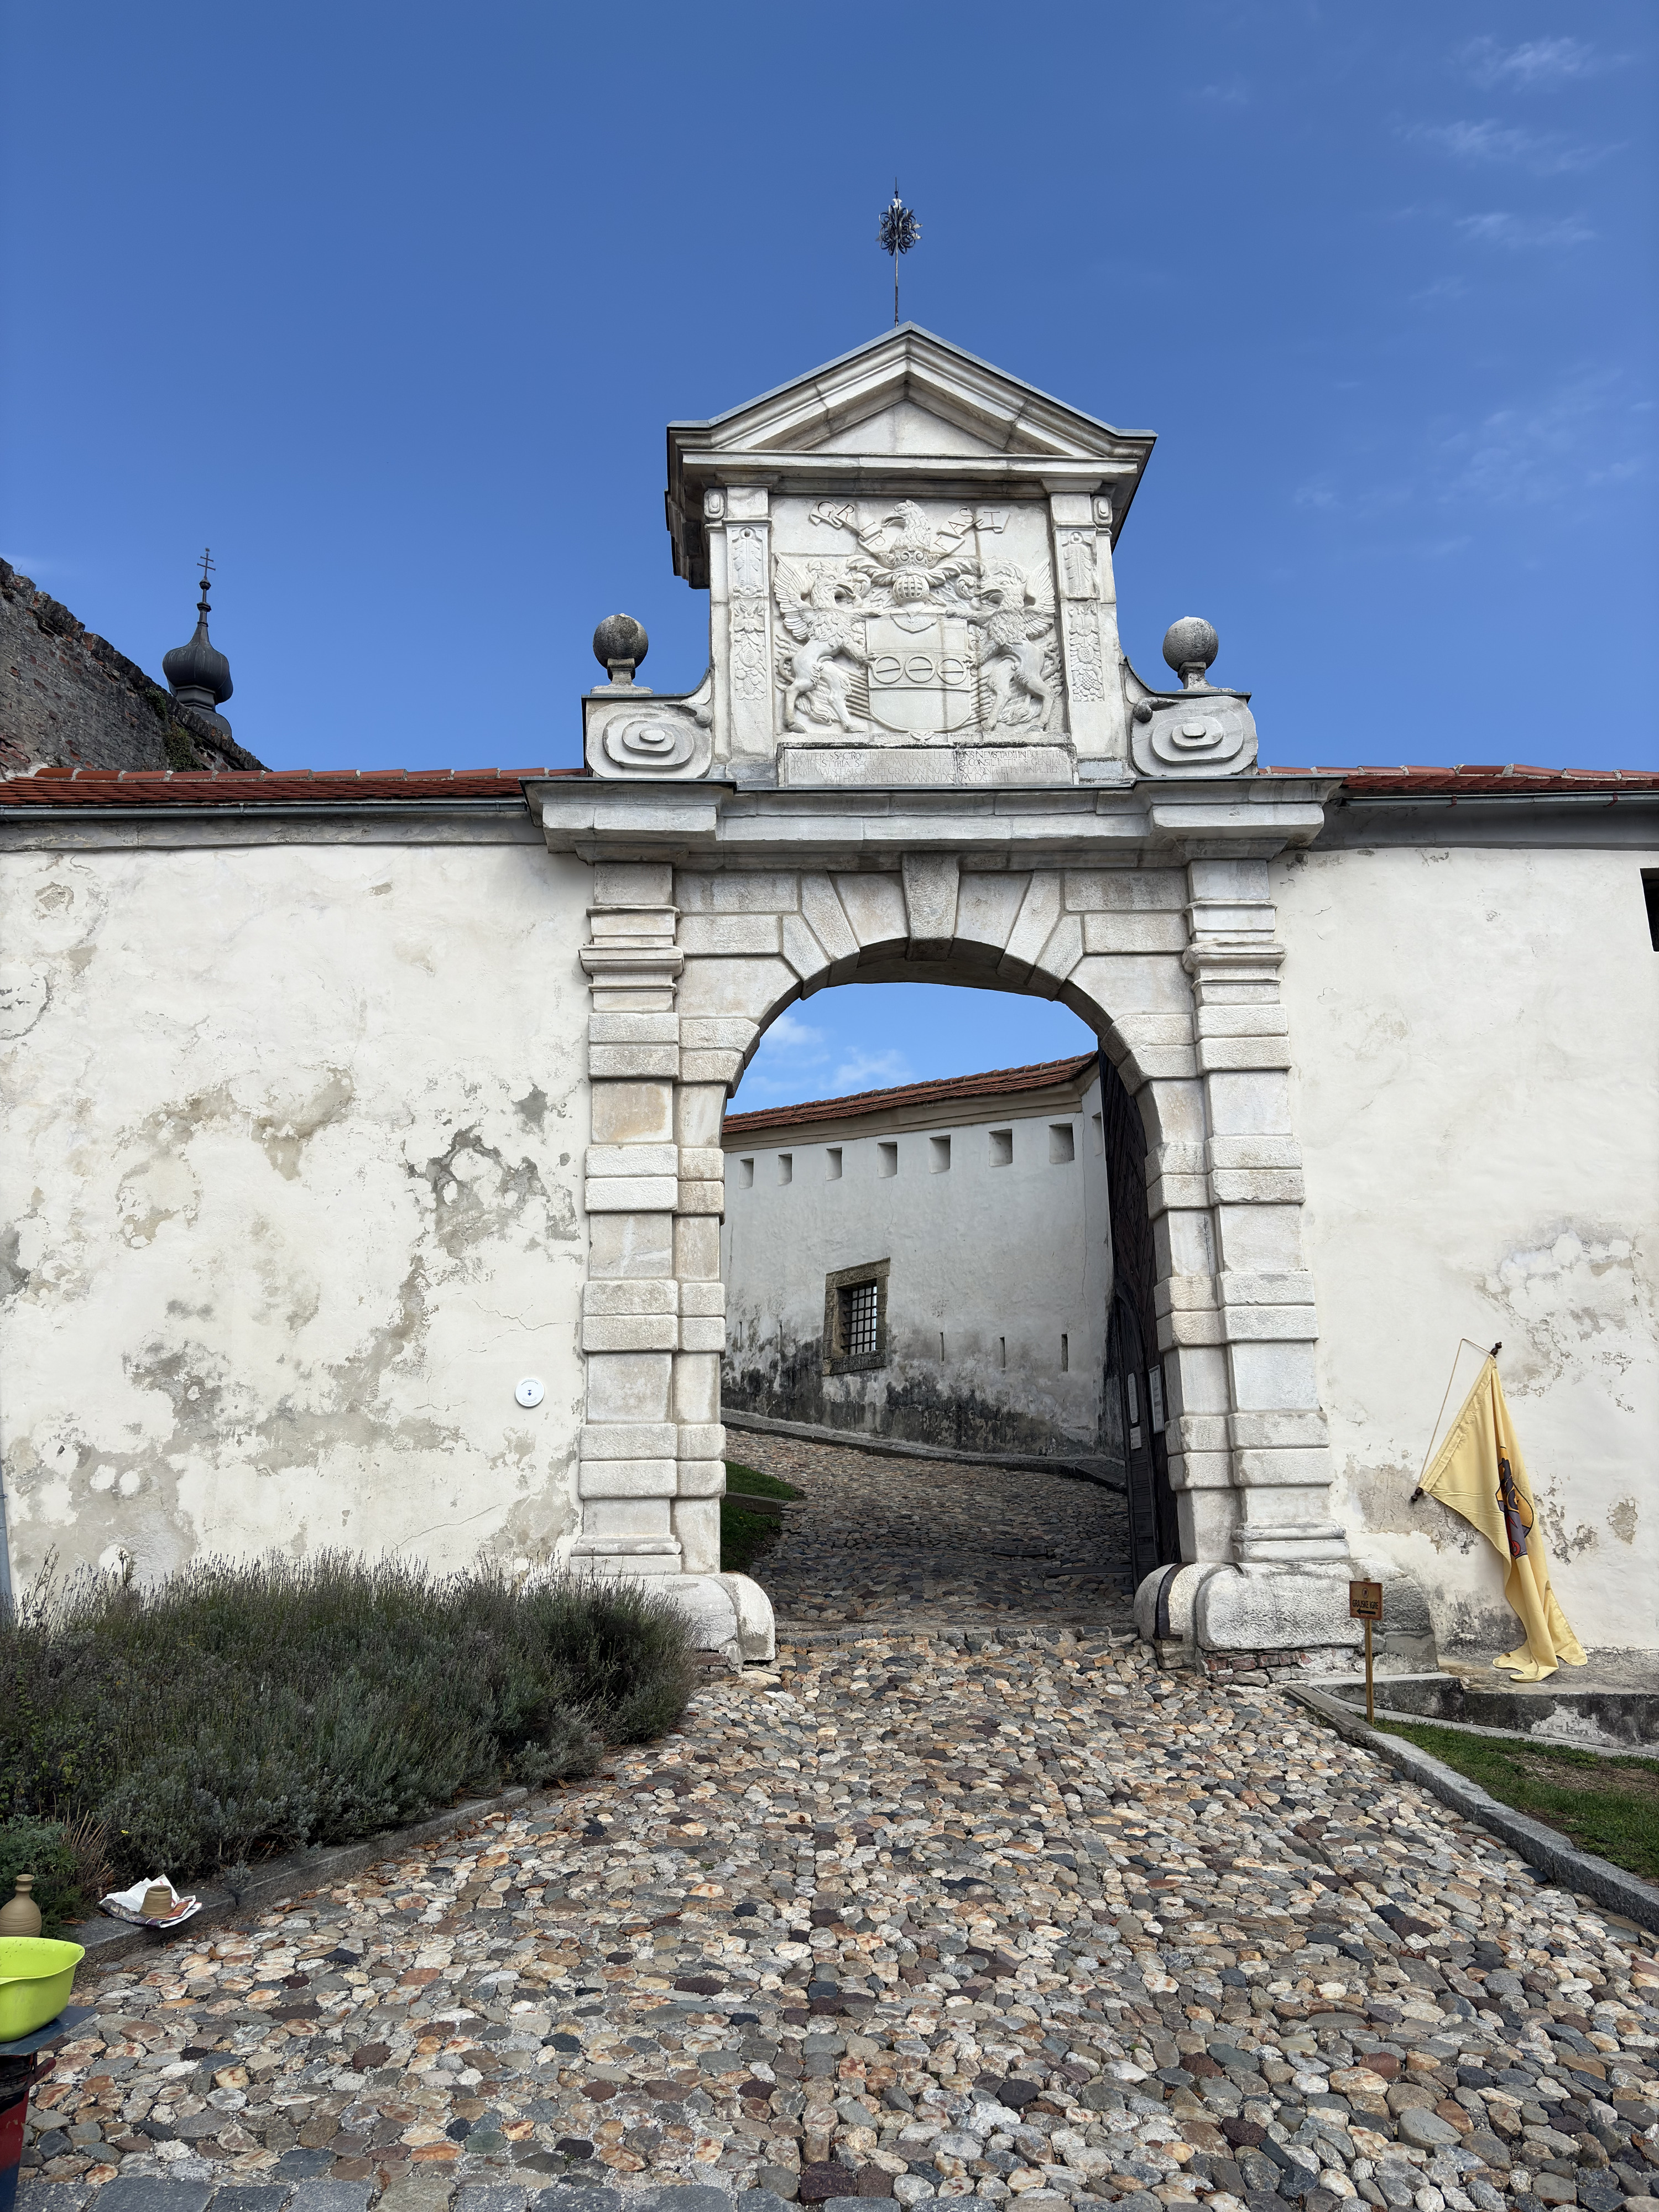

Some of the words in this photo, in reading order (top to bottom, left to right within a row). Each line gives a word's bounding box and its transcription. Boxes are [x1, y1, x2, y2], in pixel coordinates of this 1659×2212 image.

[817, 501, 886, 546] GRIP
[859, 774, 911, 782] CASTELLVM
[911, 774, 940, 782] ANNO
[1353, 1599, 1369, 1608] GRAJSKE
[1369, 1601, 1379, 1610] IGRE
